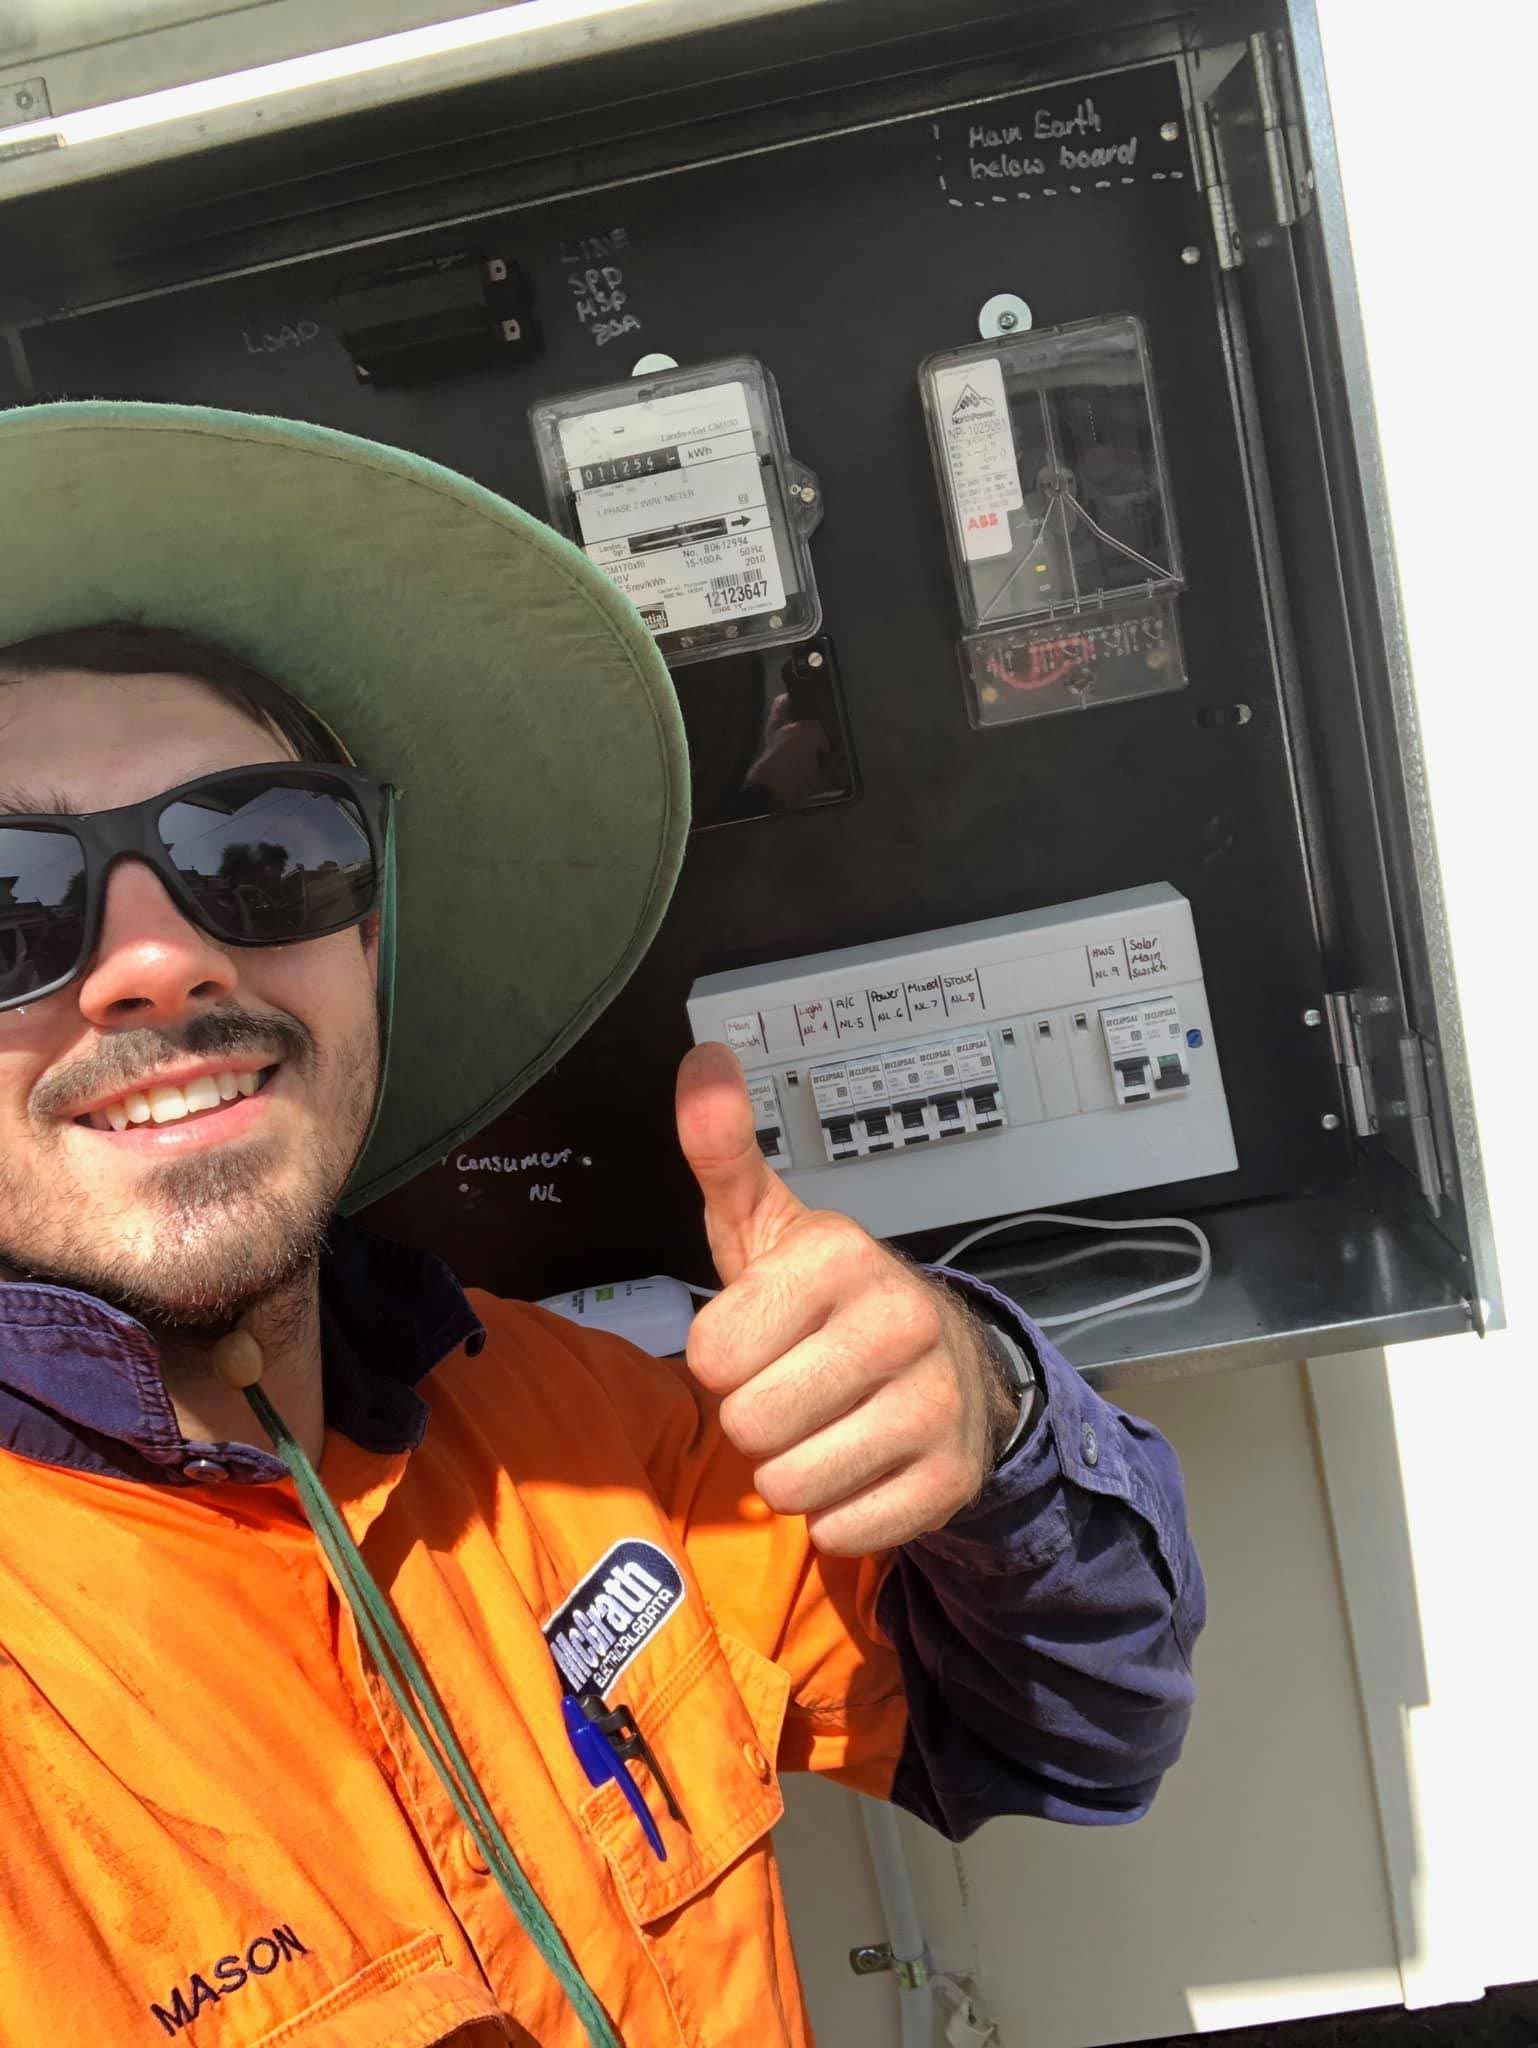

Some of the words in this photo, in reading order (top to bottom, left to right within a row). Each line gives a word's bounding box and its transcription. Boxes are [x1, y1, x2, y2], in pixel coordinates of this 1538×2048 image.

[968, 126, 1023, 148] Main
[1034, 98, 1101, 139] Earth
[969, 153, 1046, 179] below
[1060, 136, 1138, 170] board
[242, 319, 321, 354] LOAD
[687, 446, 714, 461] kWh
[663, 488, 696, 503] METER
[967, 512, 1001, 531] ABB
[743, 554, 767, 567] 2010
[703, 579, 769, 609] 12123647
[1129, 937, 1159, 951] Solar
[1092, 945, 1116, 958] HWS
[1131, 951, 1162, 964] Main
[1131, 960, 1168, 979] Switch
[907, 978, 939, 994] Mixed
[869, 987, 900, 1004] Power
[836, 996, 856, 1010] A/C
[1112, 1014, 1139, 1026] CLIPSAL
[1150, 1007, 1177, 1020] CLIPSAL
[961, 1039, 989, 1053] CLIPSAL
[925, 1048, 952, 1062] CLIPSAL
[889, 1056, 917, 1070] CLIPSAL
[819, 1071, 845, 1084] CLIPSAL
[854, 1064, 881, 1077] CLIPSAL
[550, 1561, 662, 1693] McGrath
[150, 1923, 310, 2038] MASON
